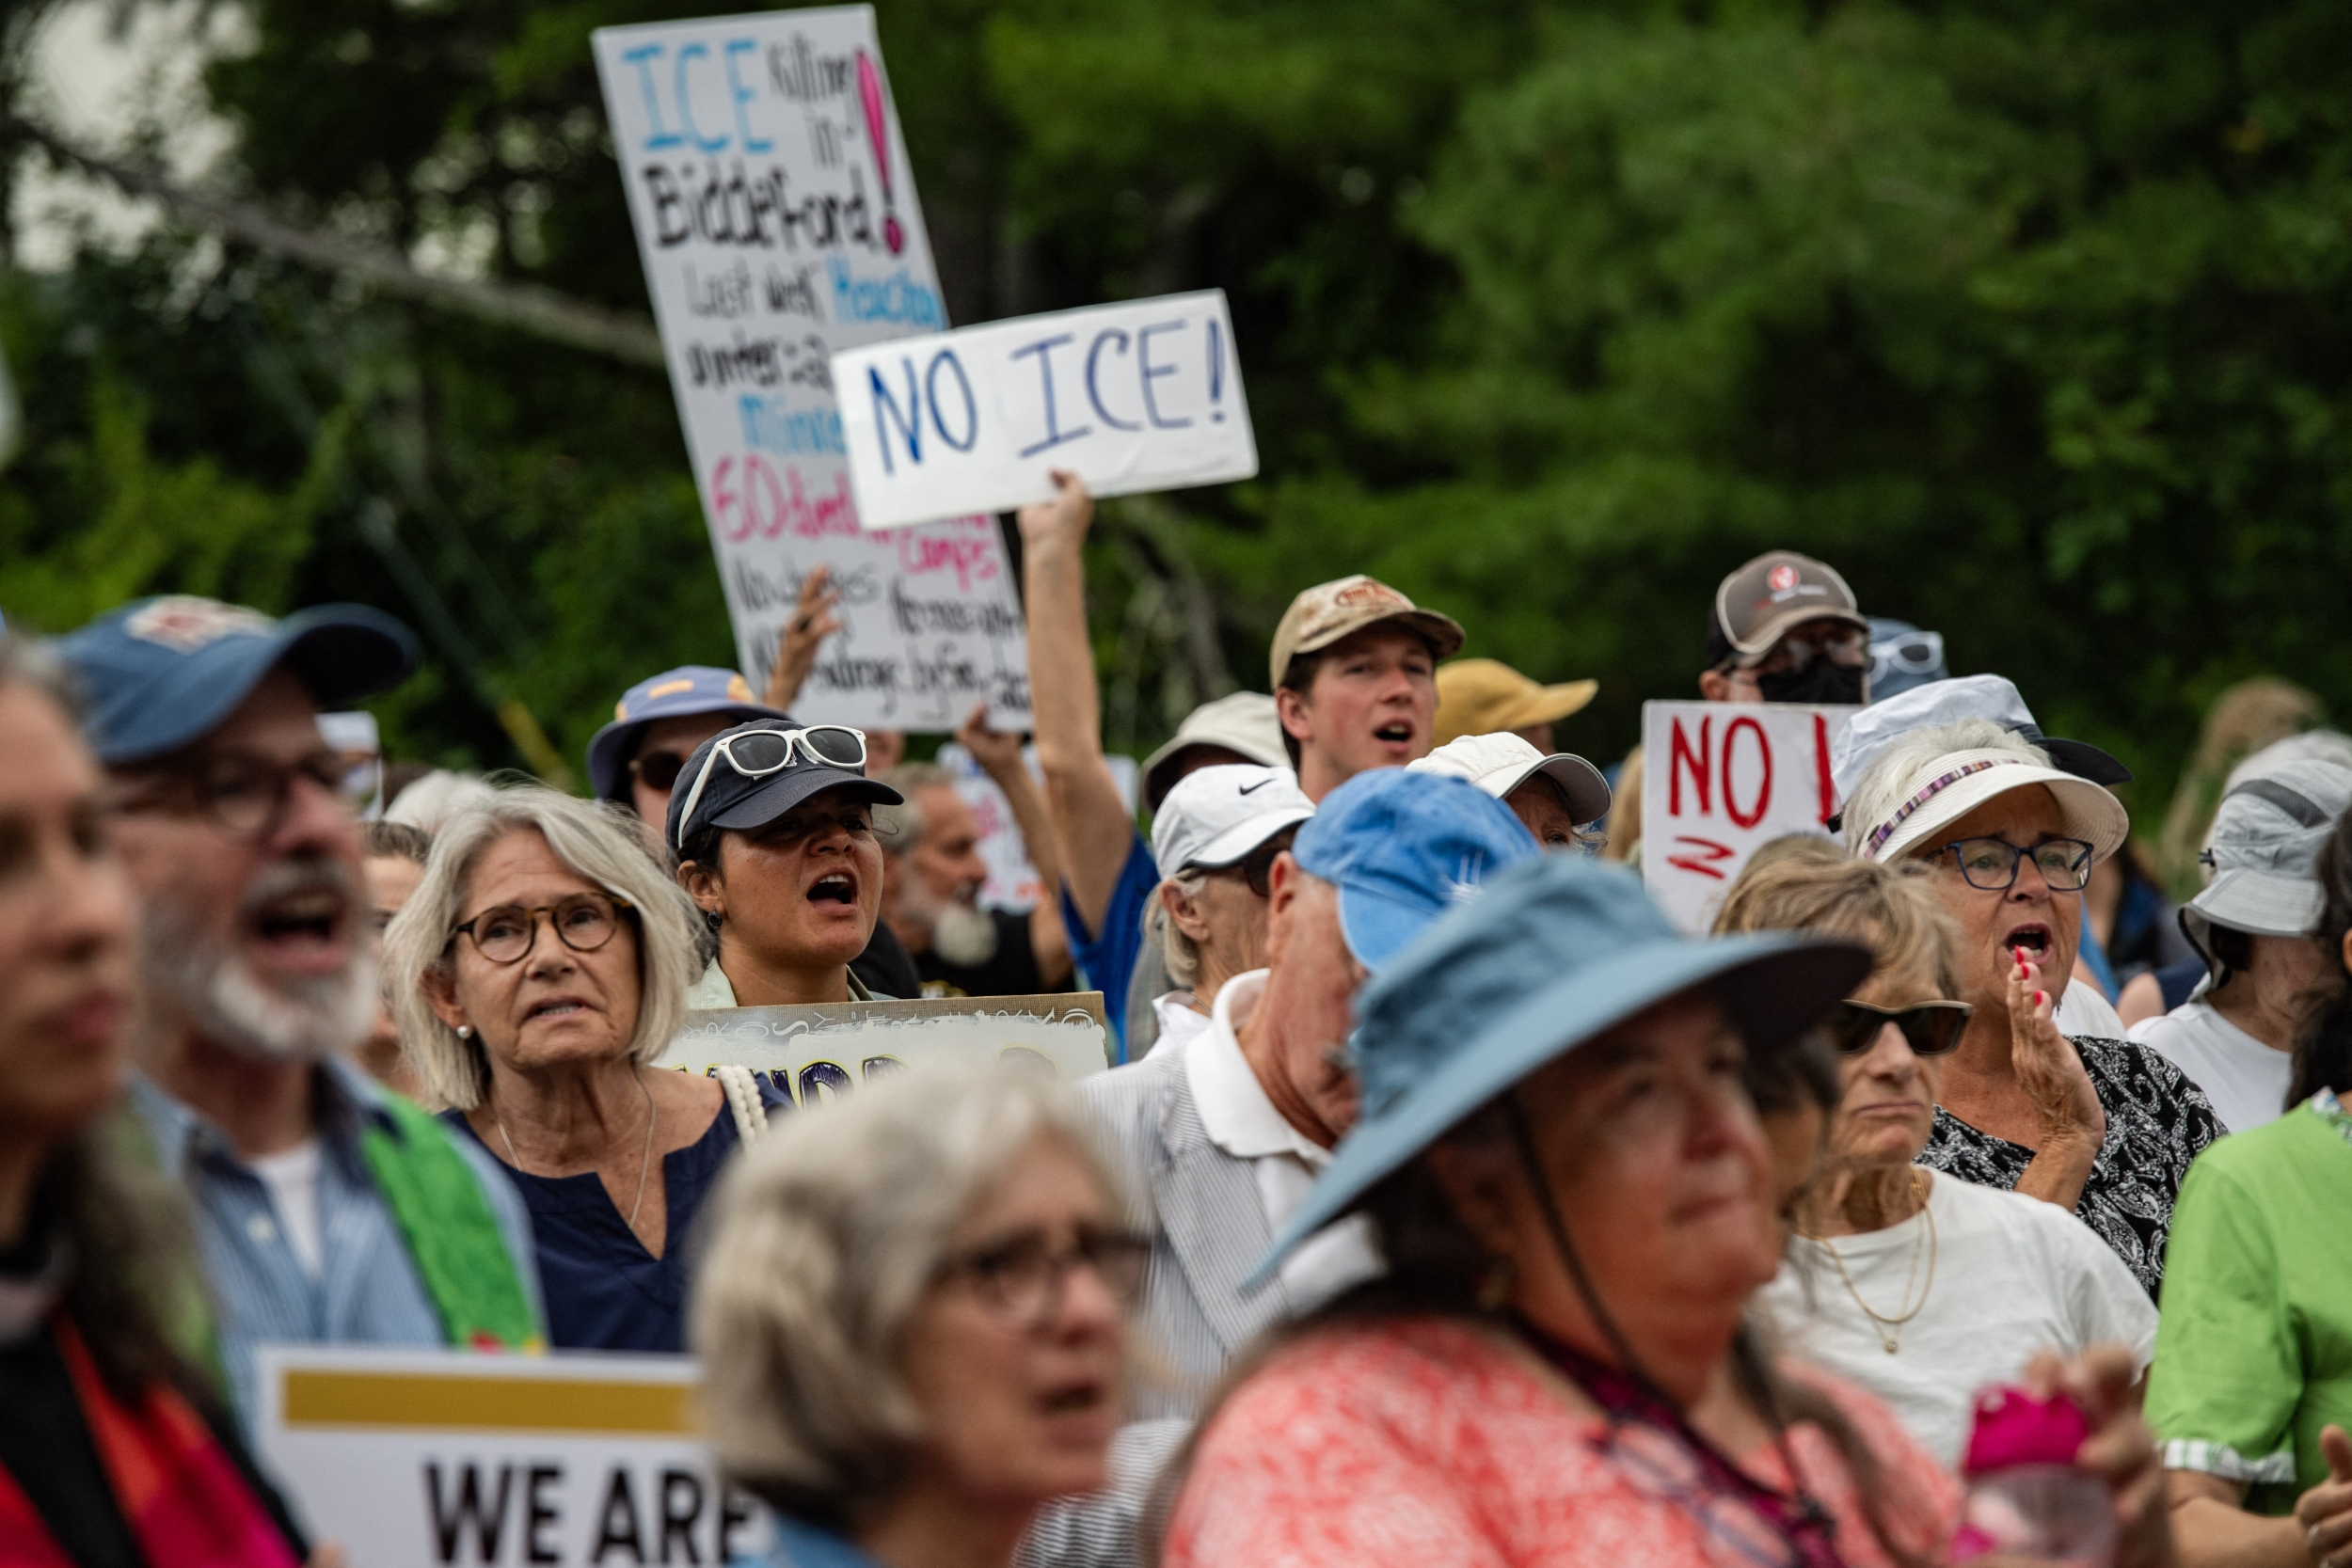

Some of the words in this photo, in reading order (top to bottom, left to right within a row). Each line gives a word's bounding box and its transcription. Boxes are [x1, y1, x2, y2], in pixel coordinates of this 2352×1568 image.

[621, 38, 775, 157] ICE
[867, 347, 977, 476] NO
[1009, 315, 1227, 460] ICE!
[1667, 713, 1774, 831] NO
[423, 1460, 566, 1565] WE
[591, 1462, 753, 1567] ARE
